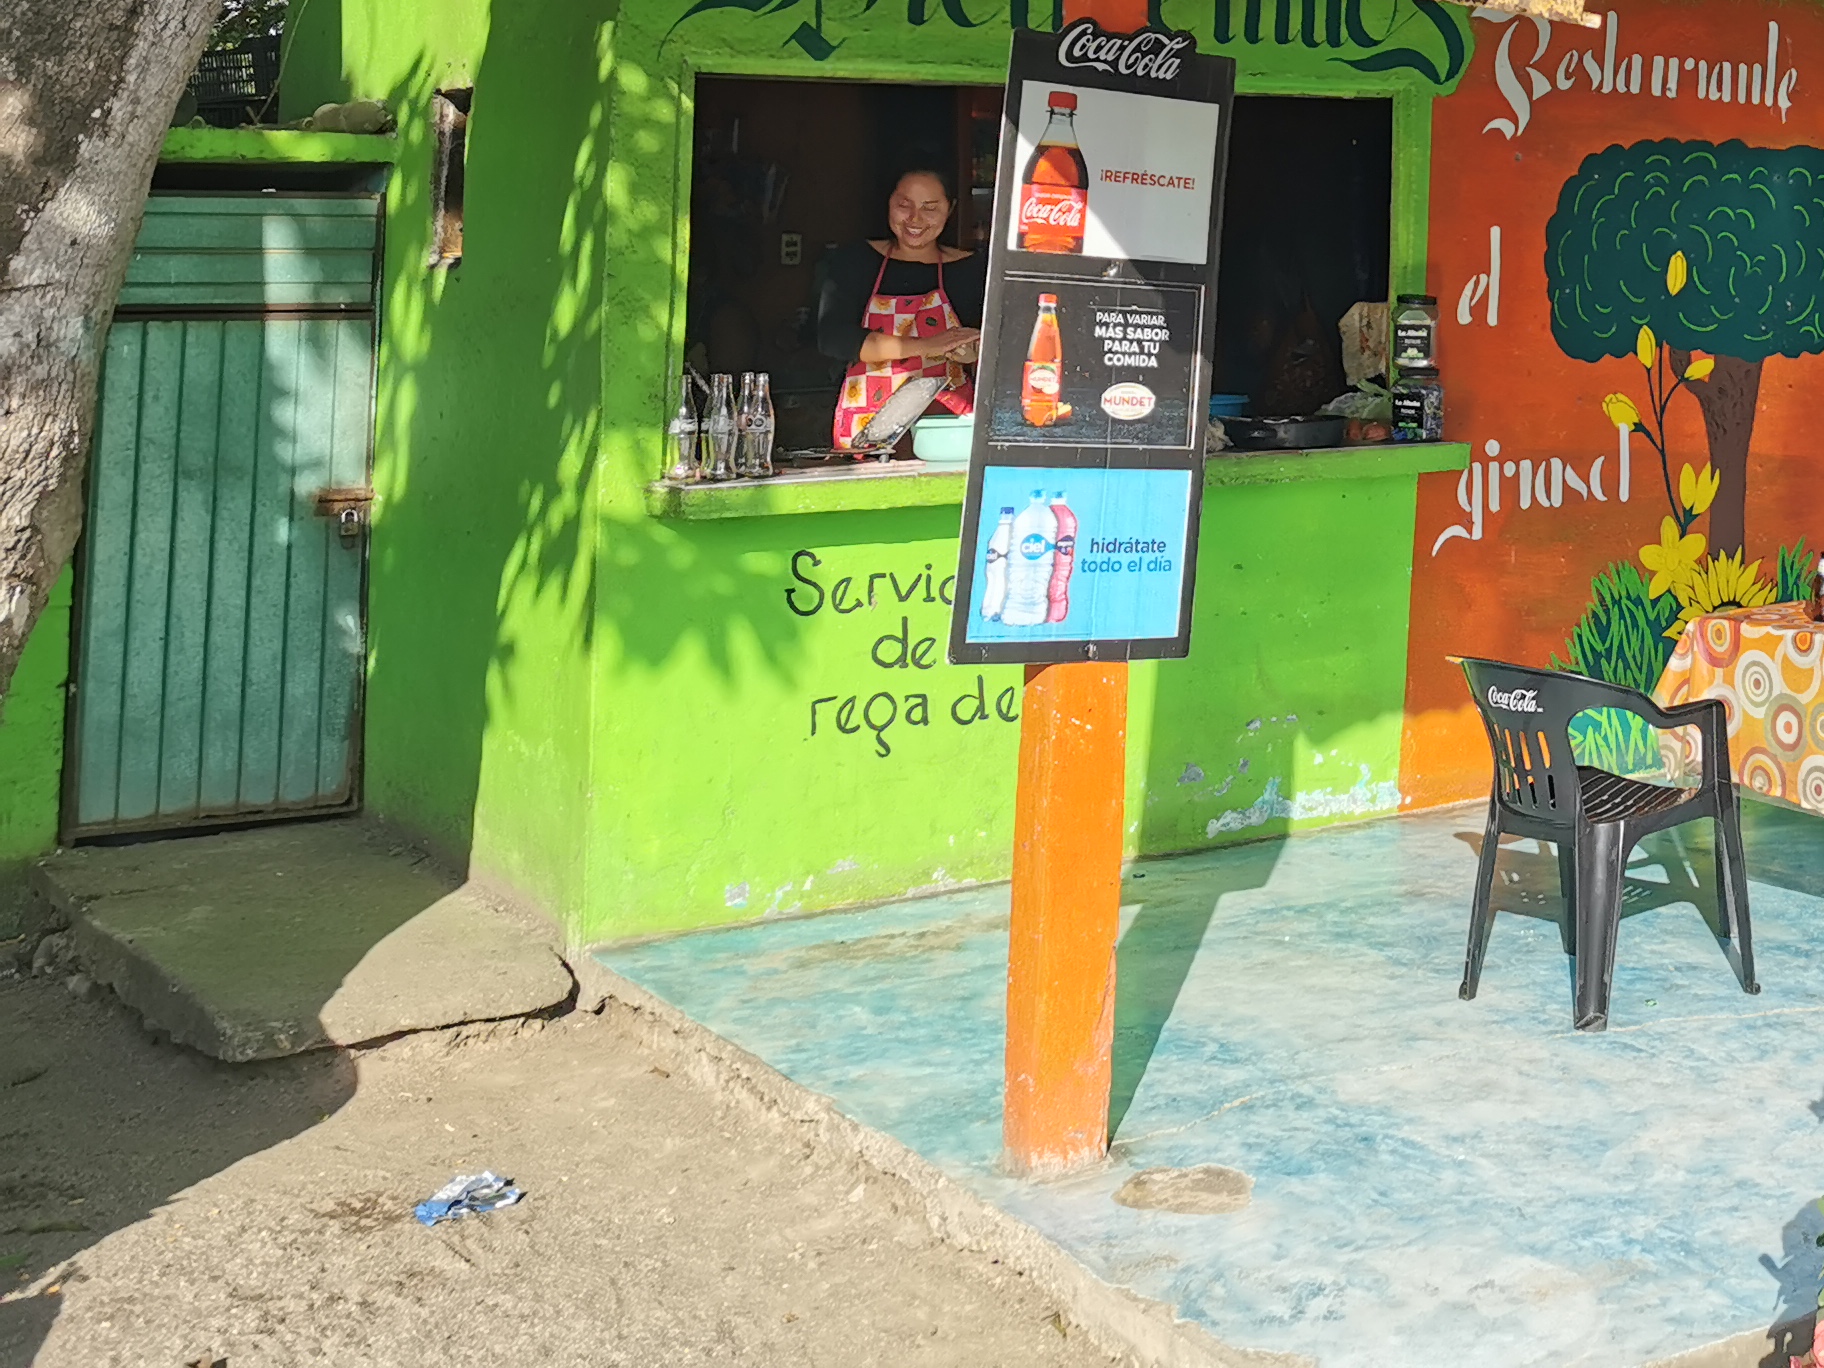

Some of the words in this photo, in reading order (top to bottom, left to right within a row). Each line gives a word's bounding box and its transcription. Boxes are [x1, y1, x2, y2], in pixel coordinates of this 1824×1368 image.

[1058, 23, 1190, 80] Coca-Cola
[1472, 7, 1799, 139] Restaurante
[1100, 169, 1195, 190] ¡REFRÉSCATE!
[1022, 197, 1084, 227] Coca-Cola
[1456, 225, 1501, 327] el
[1096, 311, 1125, 324] PARA
[1094, 323, 1123, 339] MÁS
[1126, 327, 1170, 341] SABOR
[1103, 340, 1140, 353] PARA
[1142, 342, 1160, 354] TU
[1104, 353, 1158, 368] COMIDA
[1103, 395, 1153, 407] MUNDET
[1090, 537, 1167, 554] hidrátate
[1081, 558, 1122, 573] todo
[1127, 557, 1142, 572] el
[1147, 555, 1172, 572] día
[871, 616, 937, 669] de
[1488, 685, 1538, 713] Coca-Cola
